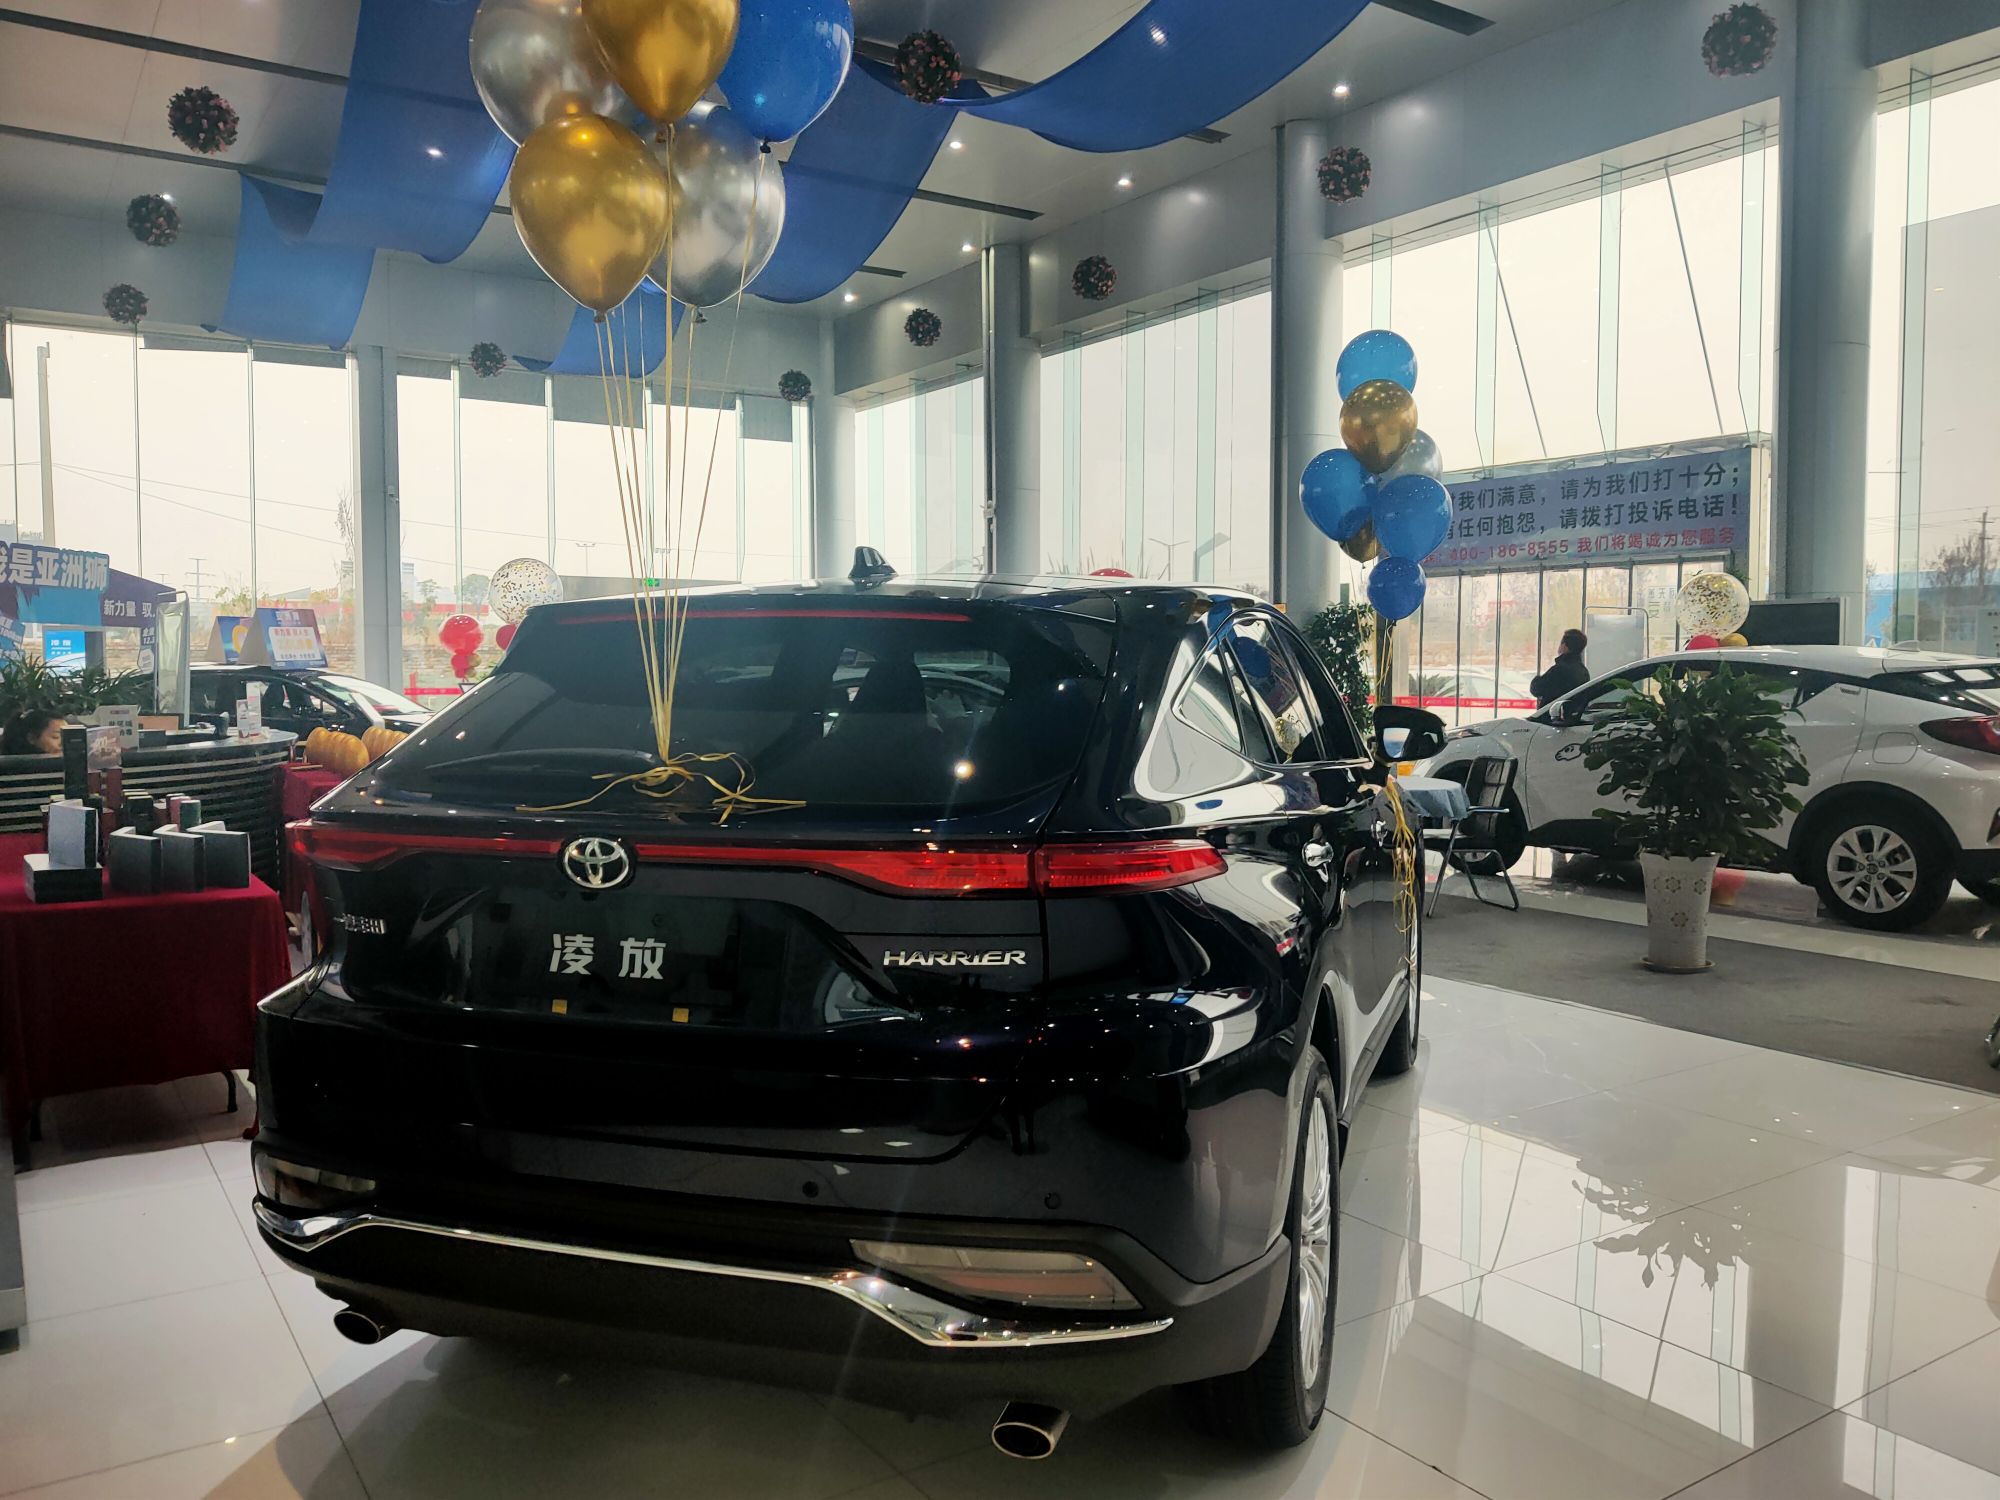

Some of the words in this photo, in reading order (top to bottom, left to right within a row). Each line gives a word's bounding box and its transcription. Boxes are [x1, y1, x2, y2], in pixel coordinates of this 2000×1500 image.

[1452, 461, 1739, 512] 我们满意，请为我们打十分；
[1576, 526, 1735, 554] 我们将竭诚为您服务
[103, 599, 137, 617] 新力量
[883, 949, 1027, 968] HARRIER
